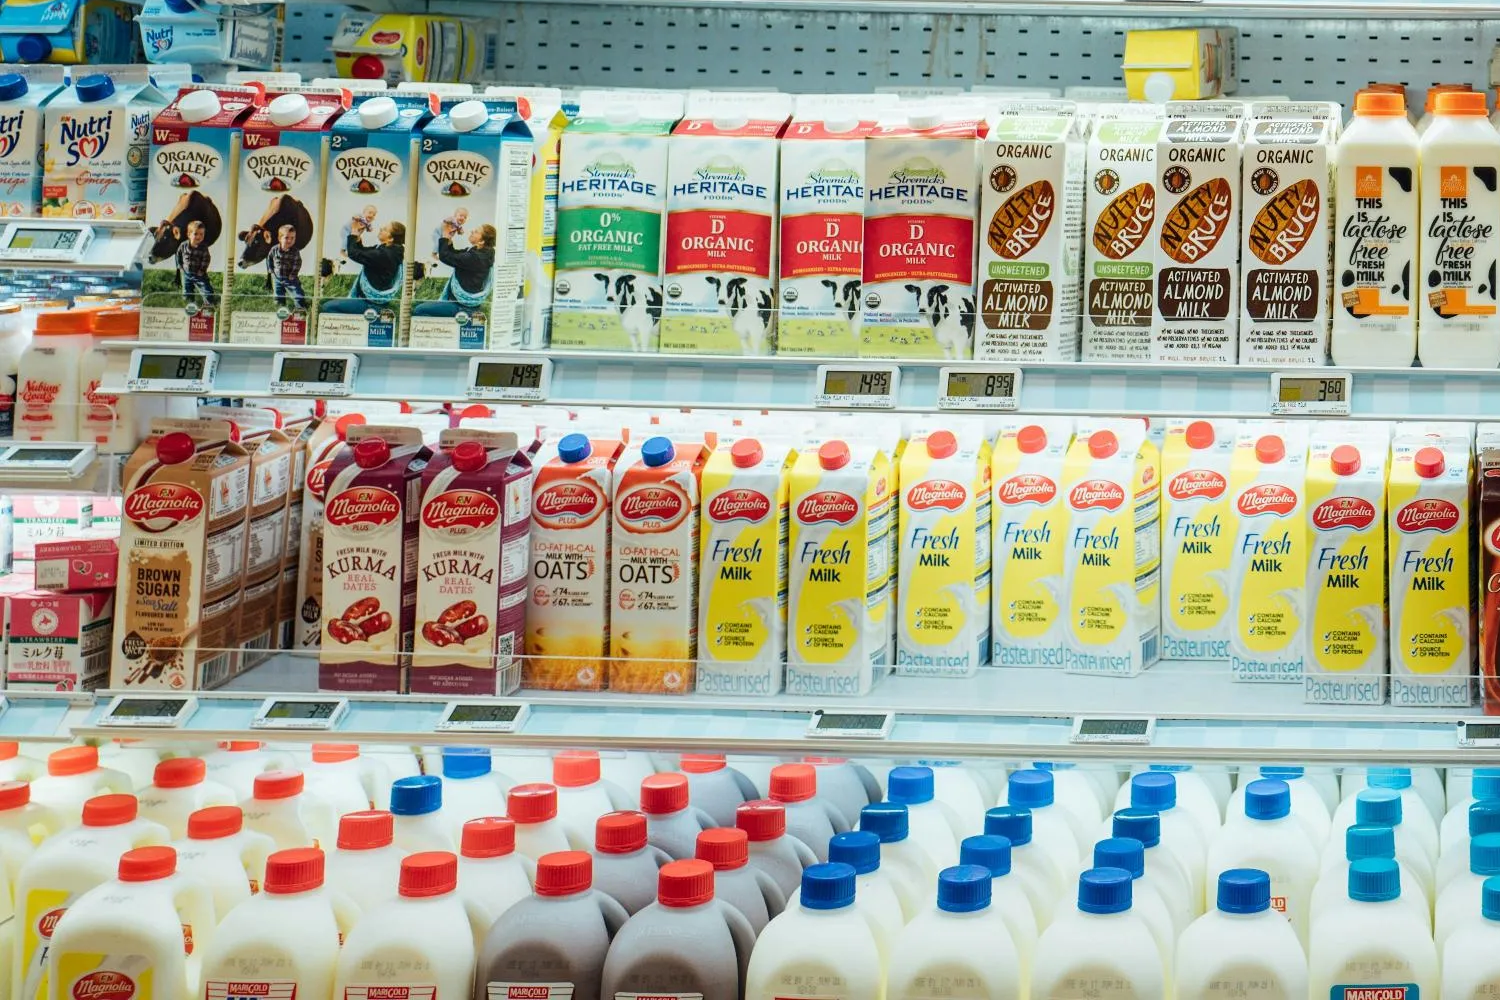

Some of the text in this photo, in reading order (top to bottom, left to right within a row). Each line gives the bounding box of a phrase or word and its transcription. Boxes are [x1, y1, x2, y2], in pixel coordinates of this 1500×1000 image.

[61, 111, 112, 148] Nutri
[156, 151, 219, 168] ORGANIC
[1169, 148, 1226, 162] ORGANIC
[162, 162, 211, 178] VALLEY
[561, 180, 657, 197] HERITAGE
[1356, 198, 1382, 209] THIS
[1161, 183, 1213, 250] NUTTY
[1183, 194, 1228, 262] BRUCE
[1343, 213, 1407, 239] lactose
[570, 228, 643, 246] ORGANIC
[592, 244, 608, 252] FREE
[610, 245, 633, 253] MILK
[879, 241, 956, 259] ORGANIC
[1351, 237, 1389, 265] free
[1096, 264, 1152, 276] UNSWEETENED
[1356, 260, 1385, 270] FRESH
[1167, 270, 1220, 284] ACTIVATED
[1356, 270, 1385, 282] MILK
[1164, 283, 1224, 301] ALMOND
[1176, 301, 1211, 319] MILK
[128, 496, 199, 516] Magnolia
[802, 500, 859, 516] Magnolia
[135, 540, 184, 549] LIMITED EDITION
[534, 544, 596, 553] LO-FAT HI-CAL
[800, 540, 851, 565] Fresh
[137, 568, 181, 583] BROWN
[326, 556, 396, 581] KURMA
[534, 560, 588, 581] OATS
[809, 567, 841, 582] Milk
[136, 582, 180, 597] SUGAR
[343, 582, 377, 591] DATES
[1393, 679, 1468, 704] Pasteurised
[73, 980, 133, 995] Magnolia
[509, 988, 548, 998] MARIGOLD
